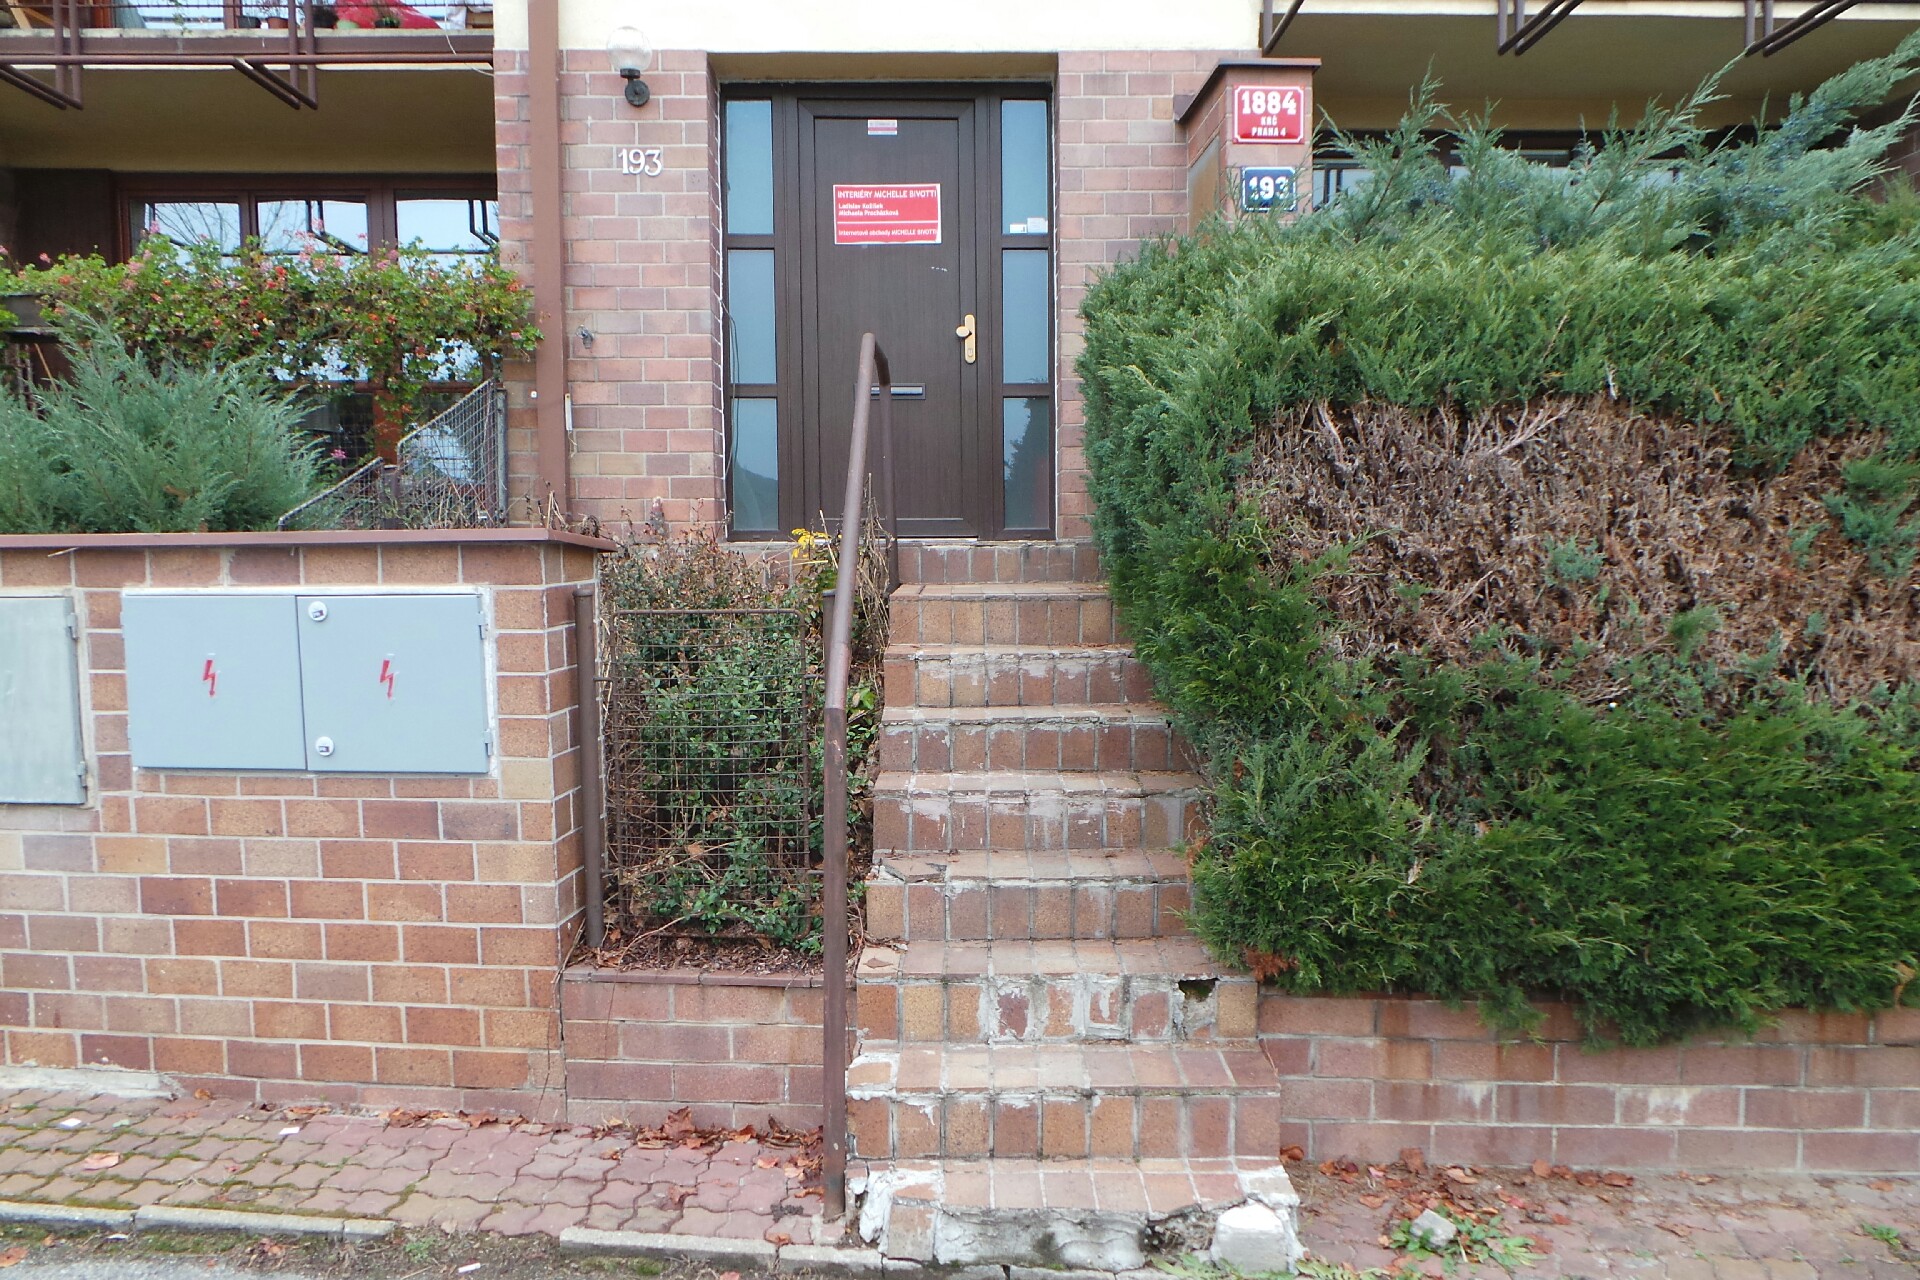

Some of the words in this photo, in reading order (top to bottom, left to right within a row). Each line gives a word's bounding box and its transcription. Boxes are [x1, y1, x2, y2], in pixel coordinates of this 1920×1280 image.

[1241, 90, 1297, 115] 1884
[1260, 115, 1277, 126] KRČ
[1251, 127, 1279, 136] PRAHA
[1279, 127, 1286, 136] 4
[618, 148, 662, 177] 193
[837, 189, 872, 198] INTERIÉRY
[873, 190, 908, 198] MICHELLE
[909, 190, 937, 198] BIVOTTI
[1249, 176, 1289, 201] 193
